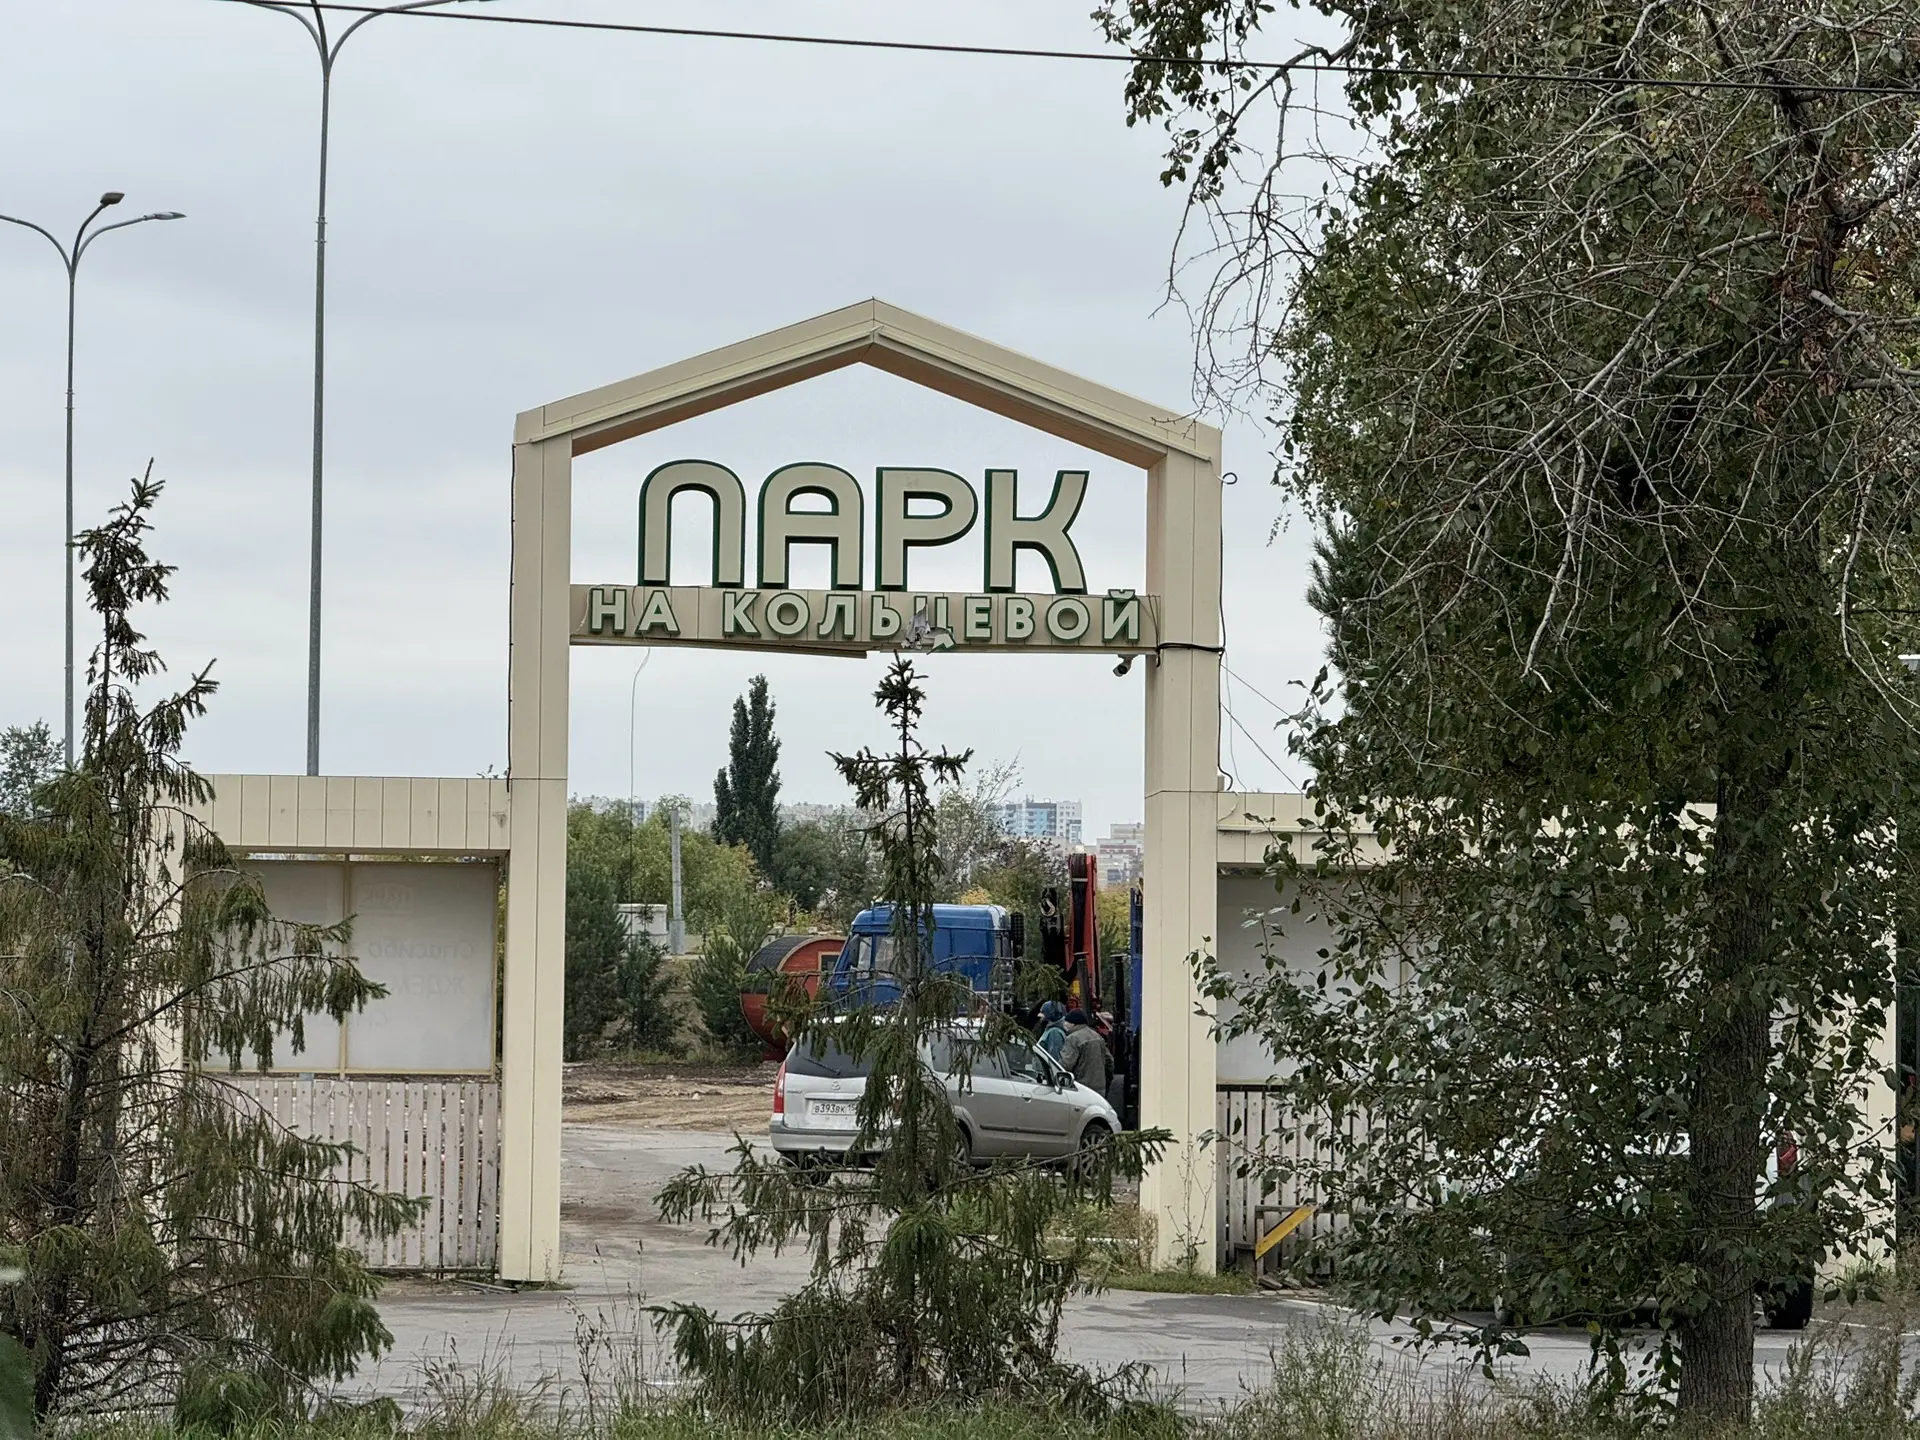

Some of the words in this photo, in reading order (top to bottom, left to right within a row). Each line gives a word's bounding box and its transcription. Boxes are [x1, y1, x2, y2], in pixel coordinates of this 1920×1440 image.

[638, 459, 1089, 595] ПАРК
[589, 588, 680, 635] НА
[722, 588, 1141, 647] КОЛЬЦЕВОЙ
